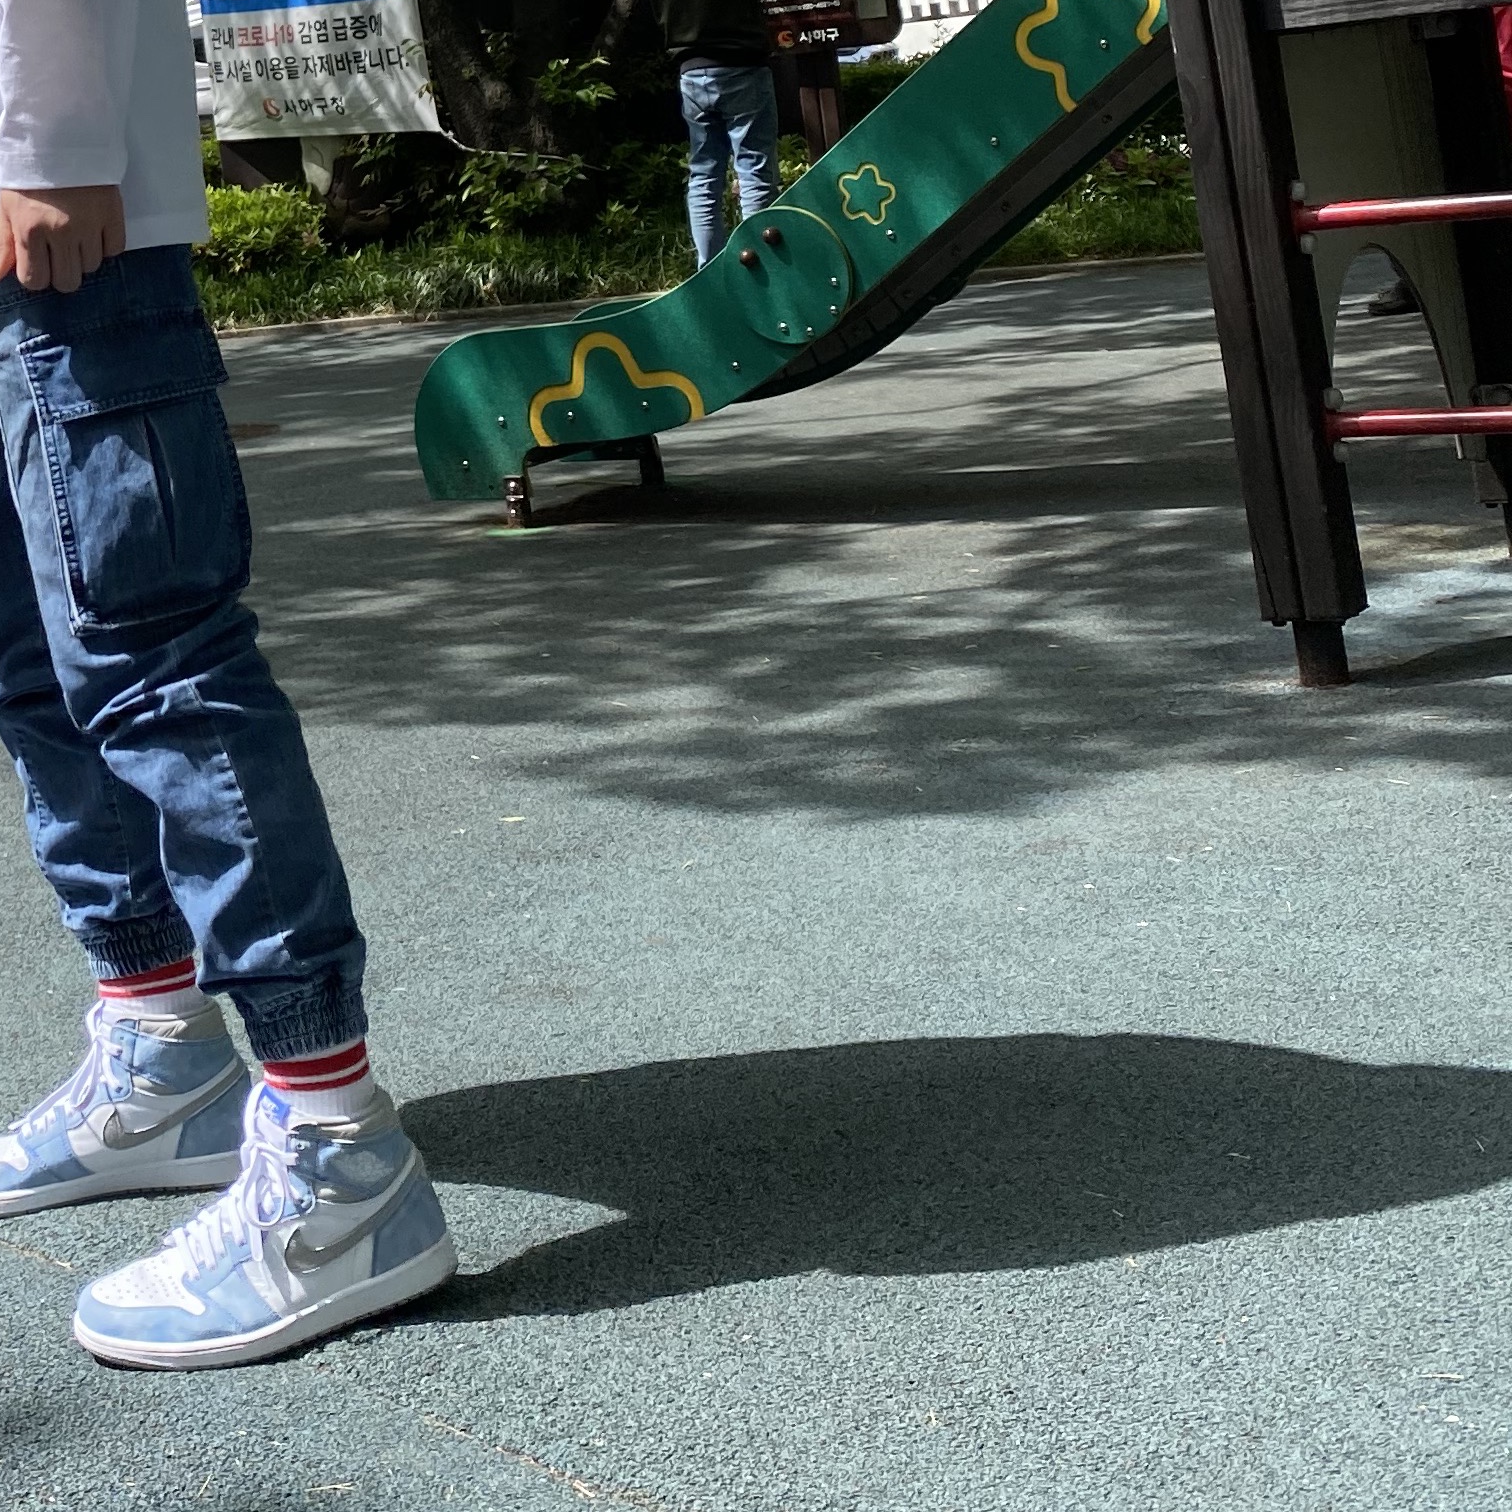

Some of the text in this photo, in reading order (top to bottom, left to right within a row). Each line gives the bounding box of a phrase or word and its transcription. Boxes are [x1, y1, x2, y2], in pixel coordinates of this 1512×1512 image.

[211, 12, 383, 50] 관내 코로나19 감염 급증에
[799, 28, 840, 44] 사하구
[227, 61, 252, 82] 시설
[255, 55, 300, 81] 이용을
[284, 95, 346, 116] 사하구청
